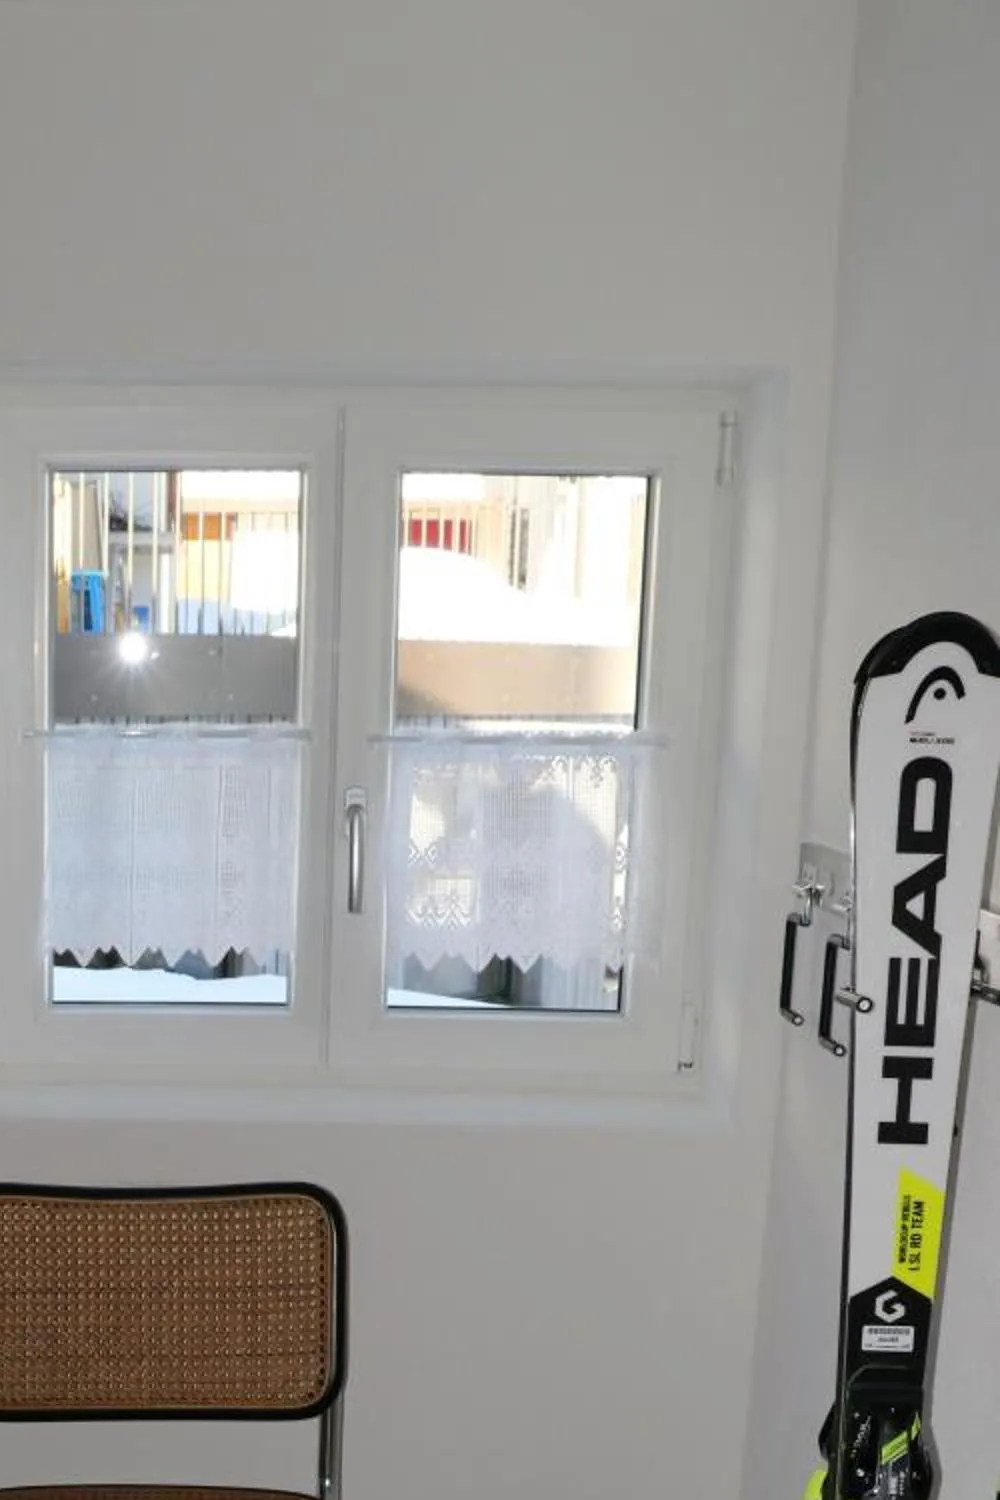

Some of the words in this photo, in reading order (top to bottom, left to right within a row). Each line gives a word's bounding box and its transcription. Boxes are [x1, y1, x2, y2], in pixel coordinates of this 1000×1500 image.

[878, 756, 952, 1144] HEAD
[911, 1201, 925, 1229] TEAM
[909, 1233, 922, 1249] RD
